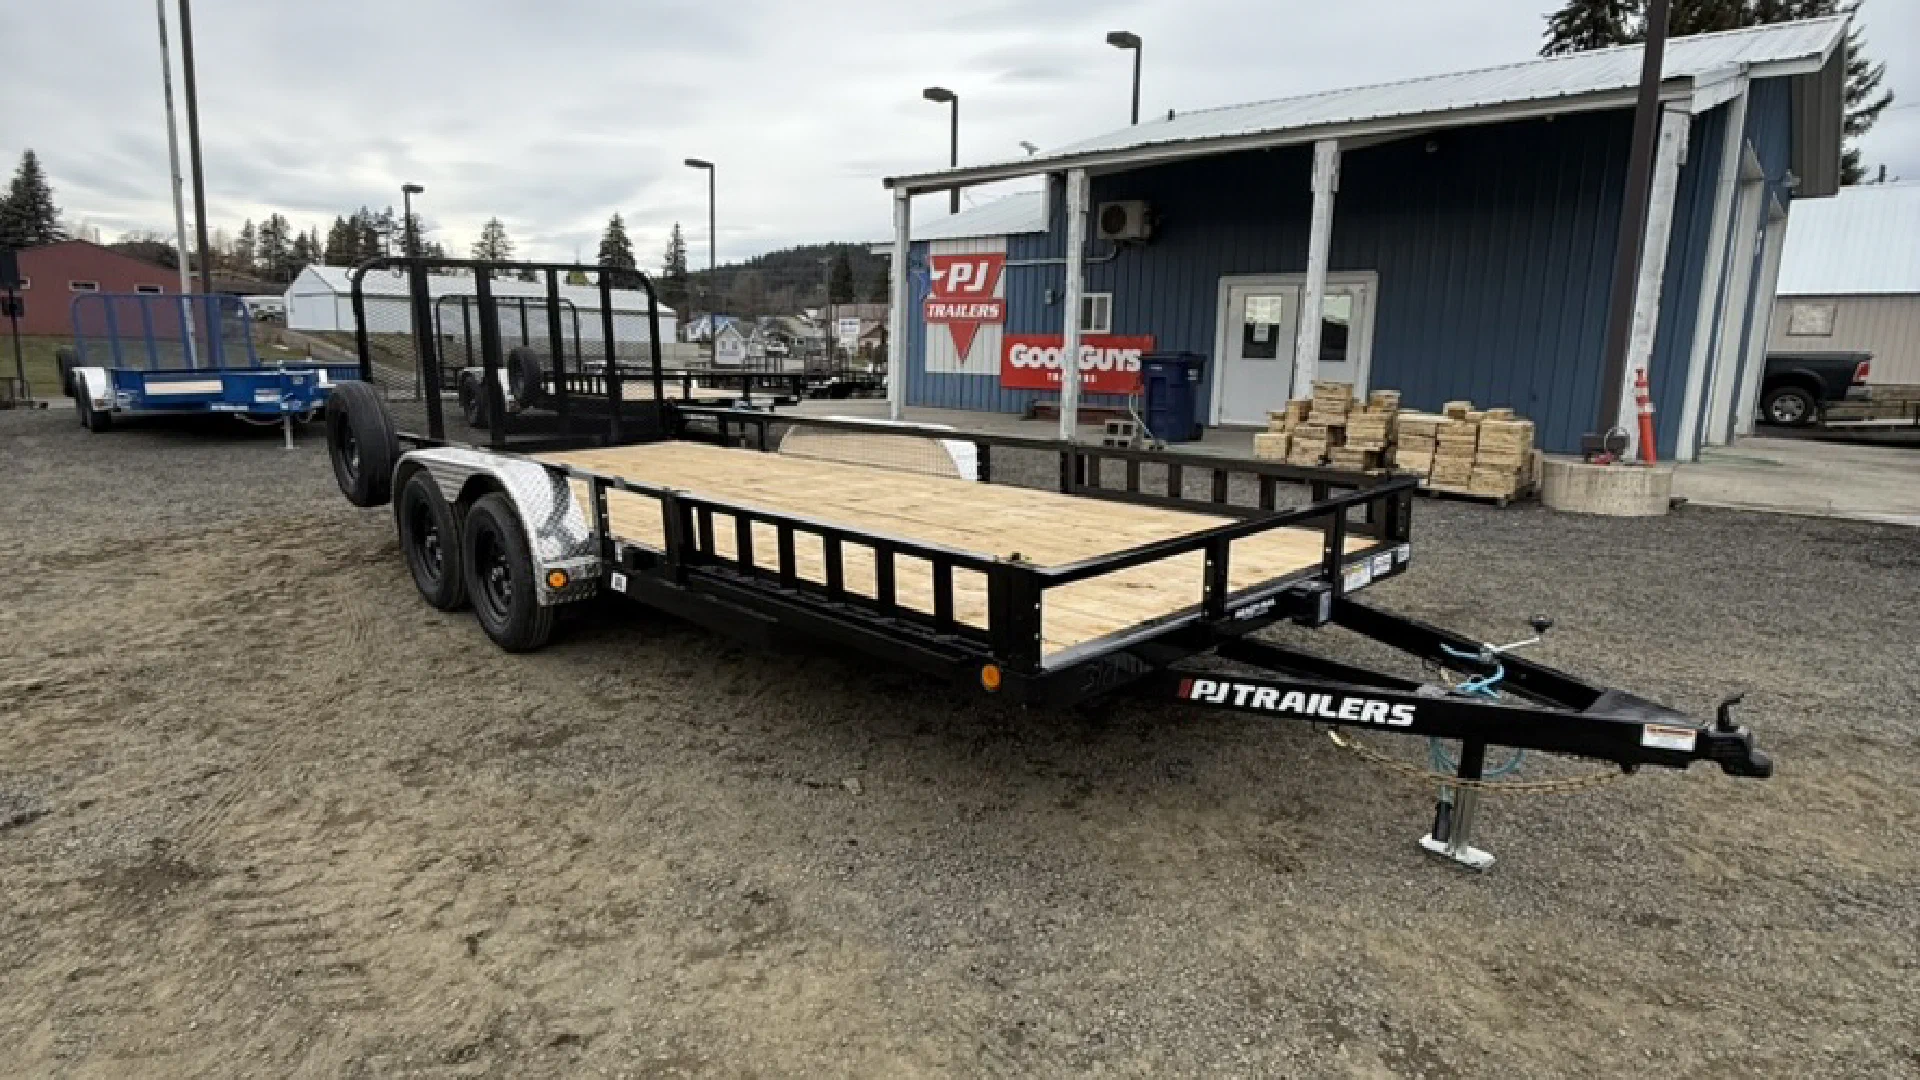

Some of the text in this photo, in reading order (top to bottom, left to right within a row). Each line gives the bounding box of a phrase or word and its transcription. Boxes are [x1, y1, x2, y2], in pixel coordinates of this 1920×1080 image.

[946, 262, 989, 291] PJ
[927, 303, 999, 318] TRAILERS
[1010, 343, 1142, 371] GOO GUYS
[1190, 679, 1416, 726] PJ TRAILERS
